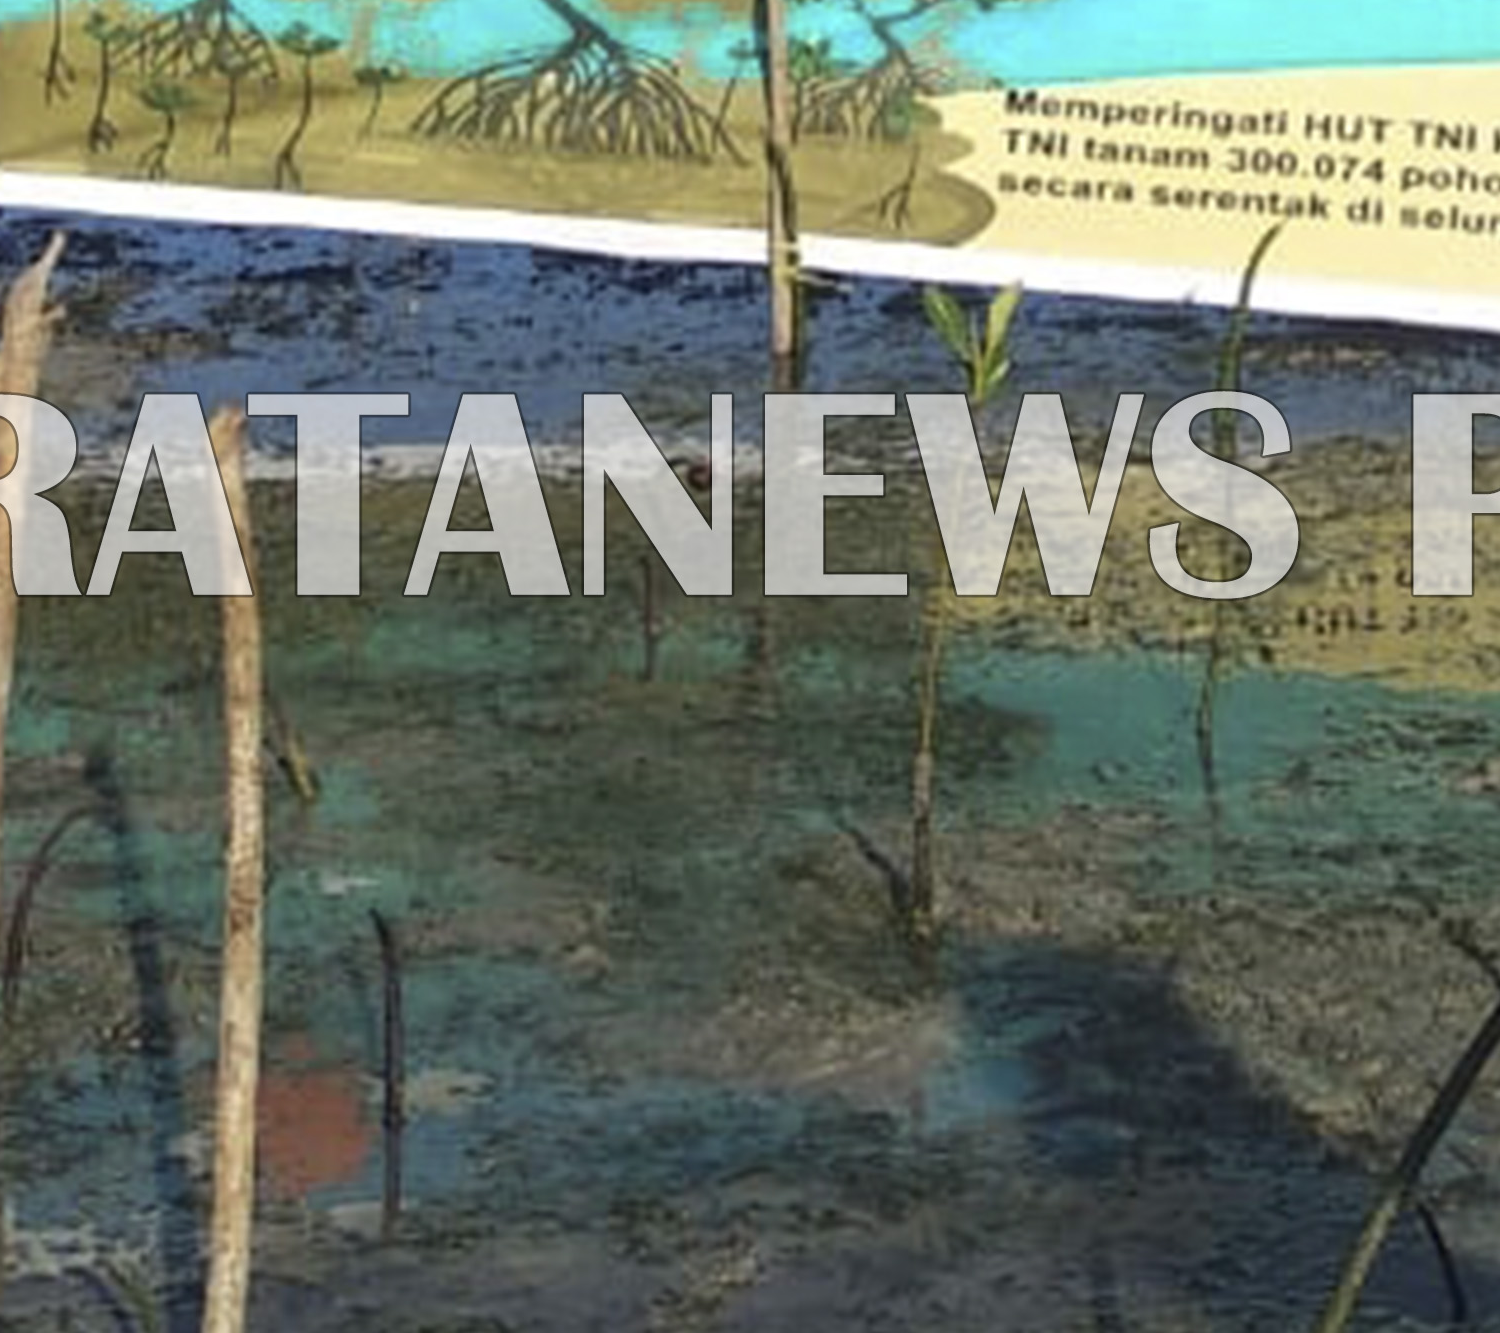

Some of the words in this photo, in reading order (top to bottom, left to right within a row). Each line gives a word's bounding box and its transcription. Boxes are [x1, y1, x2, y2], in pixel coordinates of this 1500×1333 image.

[1003, 89, 1290, 136] Memperingati
[1303, 112, 1393, 143] HUT
[1409, 120, 1478, 153] TNI
[1003, 128, 1070, 160] TNI
[1081, 136, 1212, 171] tanam
[1225, 147, 1387, 185] 300.074
[996, 171, 1136, 203] secara
[1148, 185, 1333, 220] serentak
[1344, 197, 1385, 226] di
